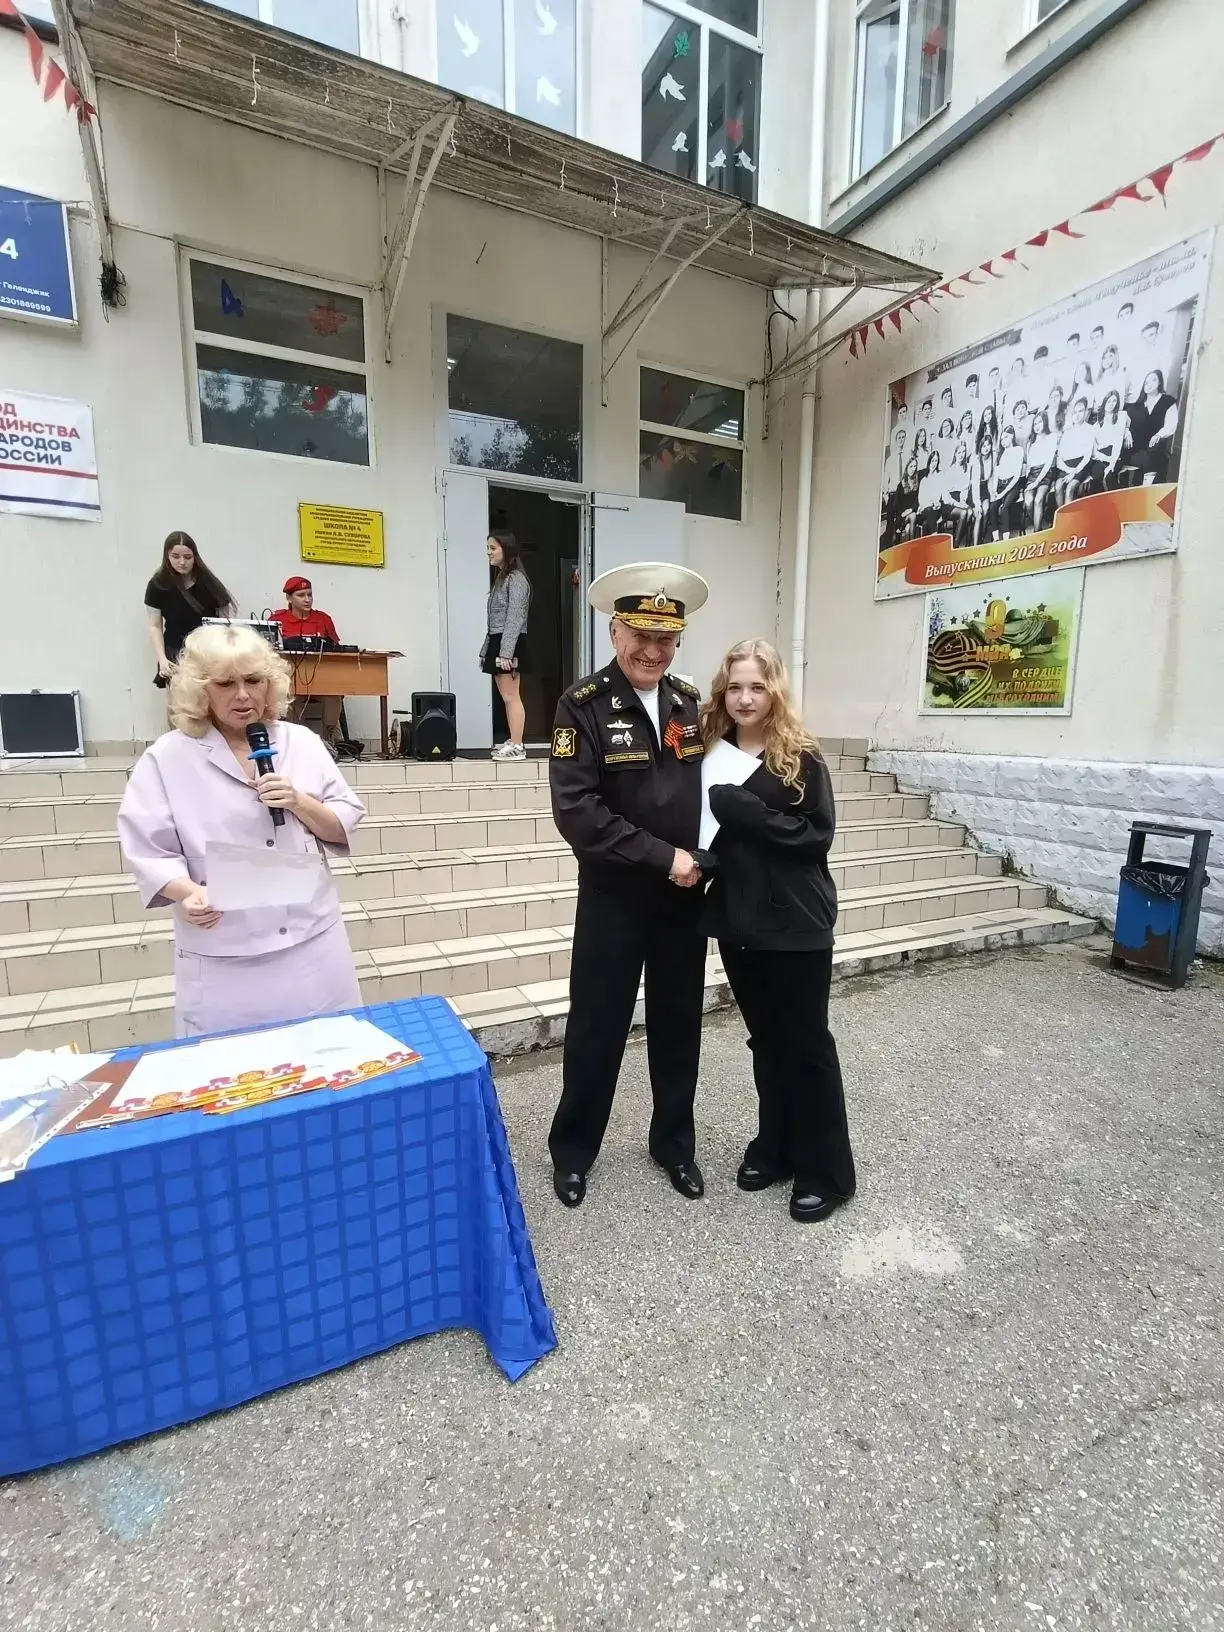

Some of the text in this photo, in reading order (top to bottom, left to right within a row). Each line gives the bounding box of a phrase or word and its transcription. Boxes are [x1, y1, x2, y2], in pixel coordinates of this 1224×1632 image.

[0, 238, 18, 260] 4
[925, 535, 1088, 578] Выпускники 2021 года
[984, 599, 1007, 640] 9
